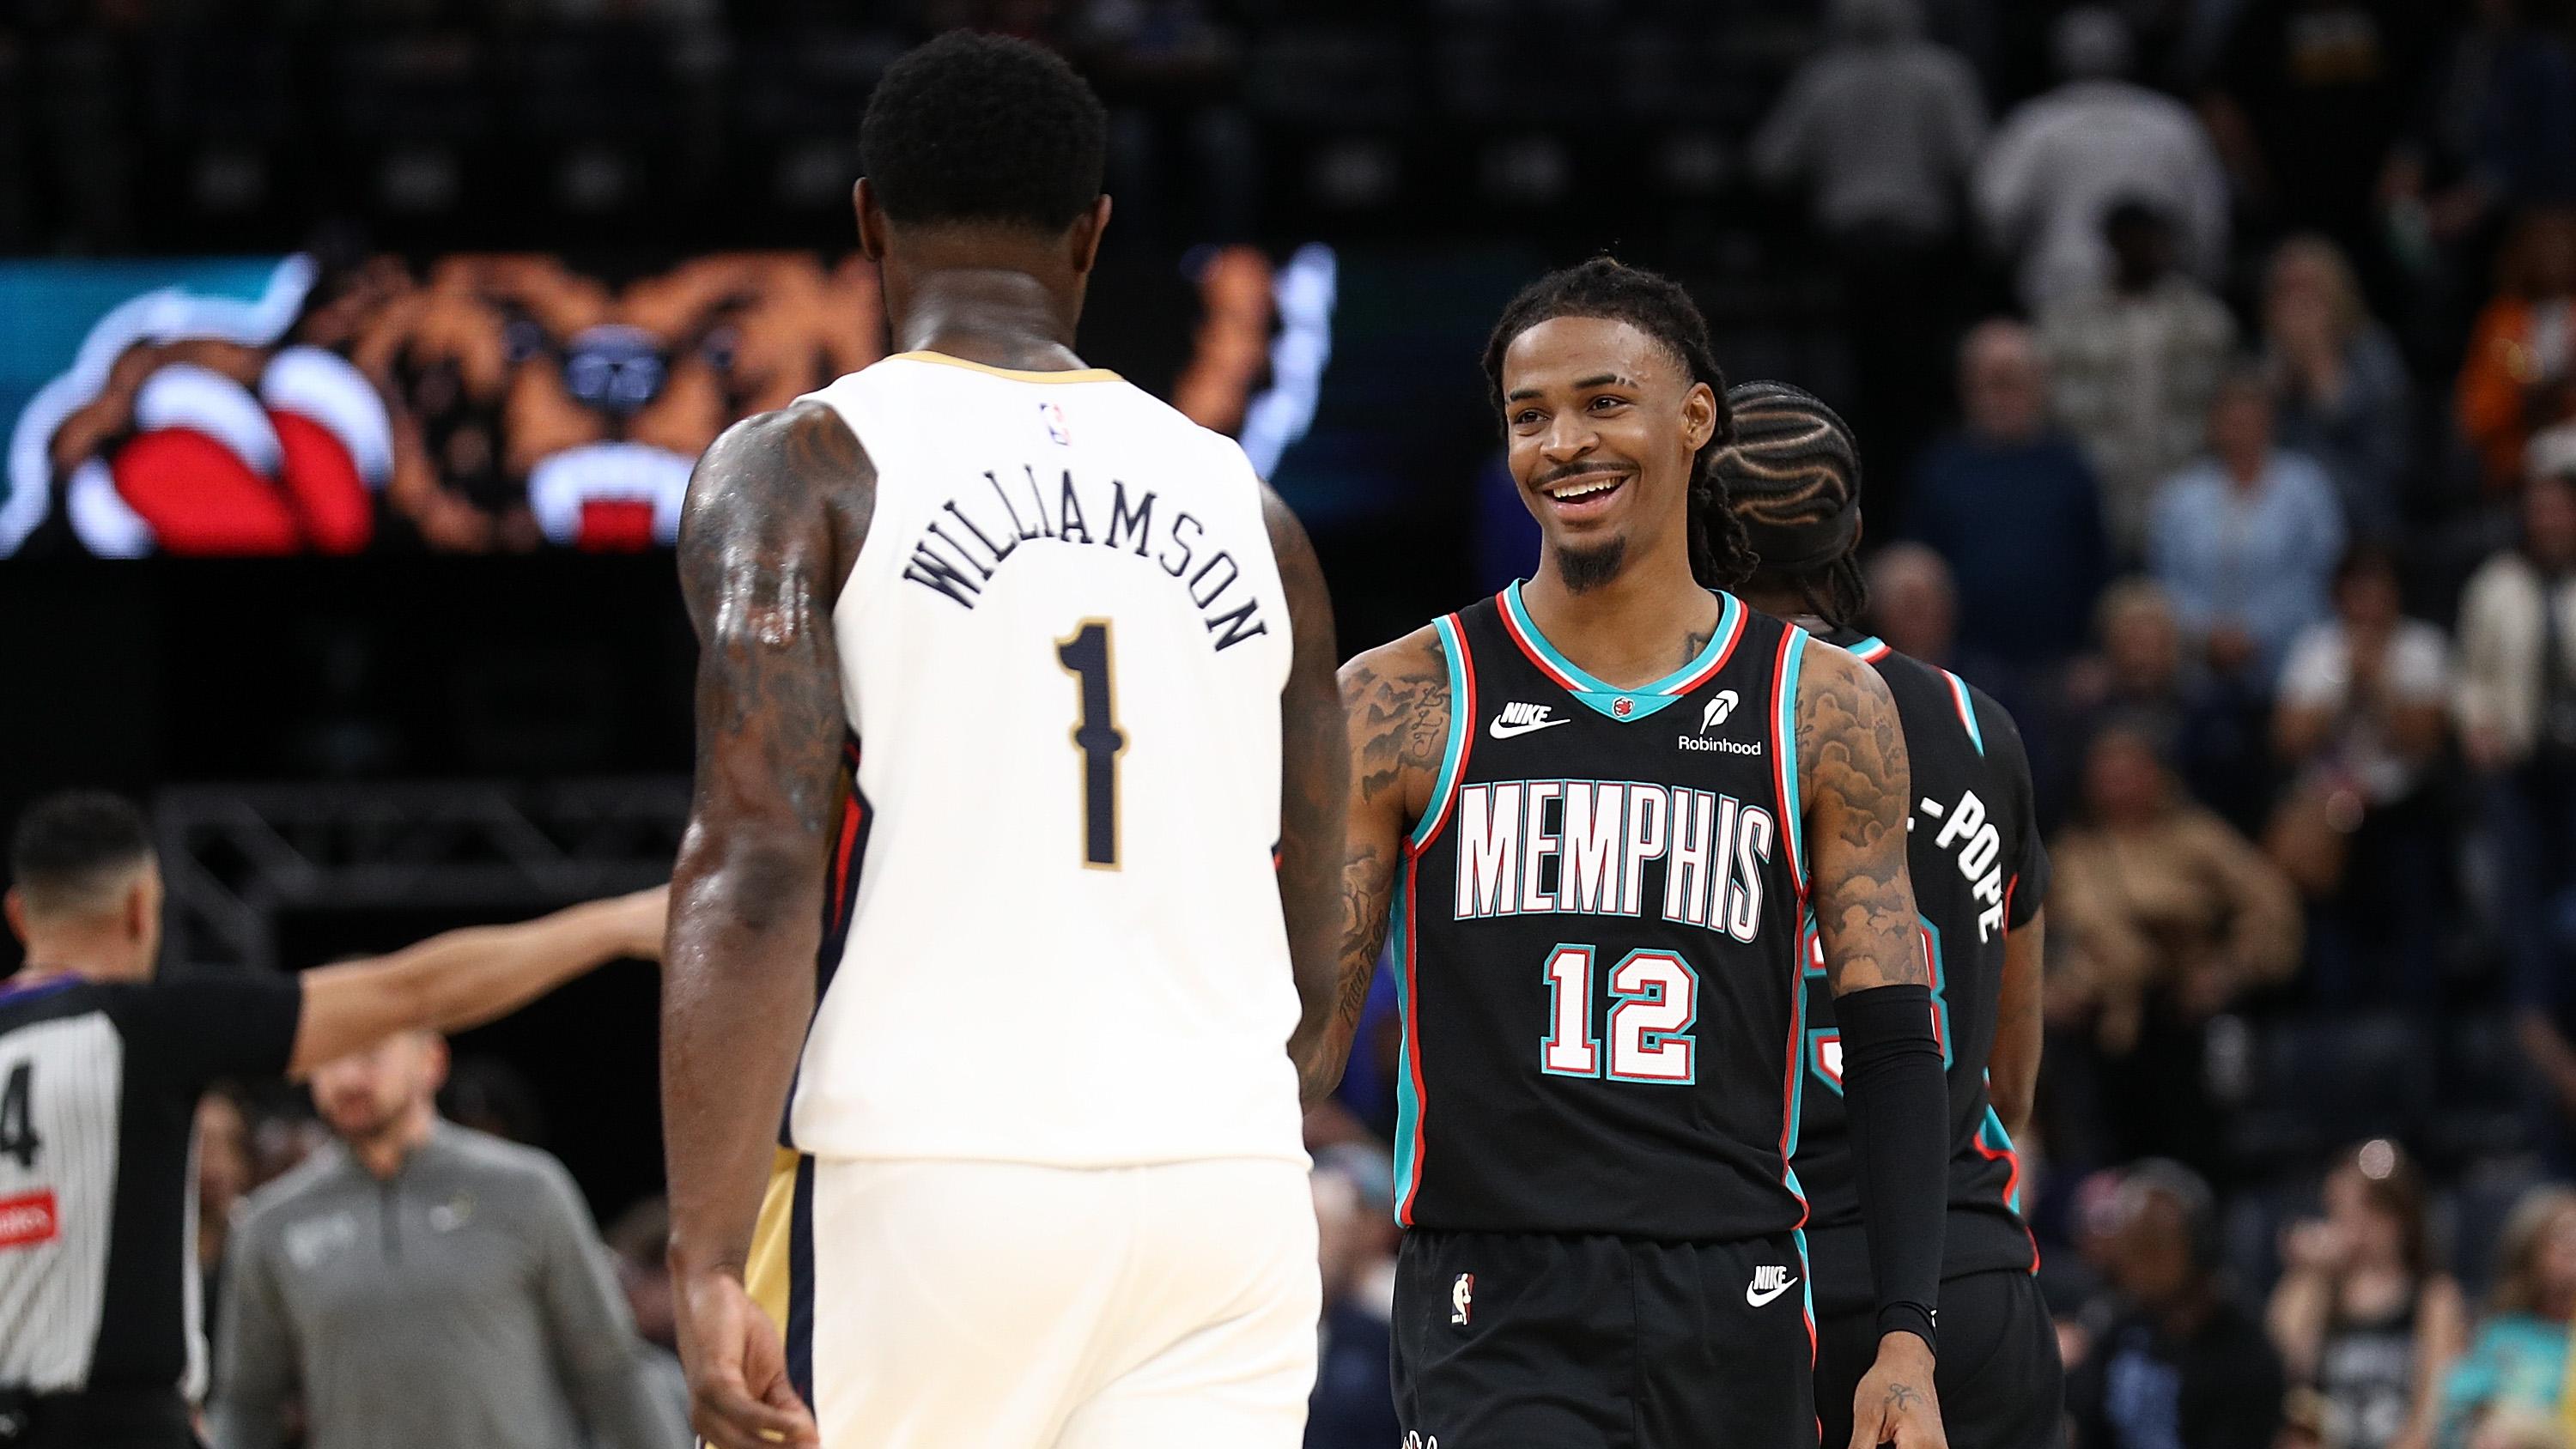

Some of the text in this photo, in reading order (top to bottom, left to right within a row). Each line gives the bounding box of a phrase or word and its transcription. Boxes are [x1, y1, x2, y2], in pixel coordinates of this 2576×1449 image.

[902, 464, 1268, 652] WILLIAMSON
[1053, 615, 1131, 873] 1
[1500, 701, 1552, 724] NIKE
[1677, 735, 1762, 756] Robinhood
[1454, 779, 1774, 944] MEMPHIS
[1906, 789, 2005, 944] -POPE
[1540, 943, 1698, 1086] 12
[1753, 1265, 1787, 1290] NIKE
